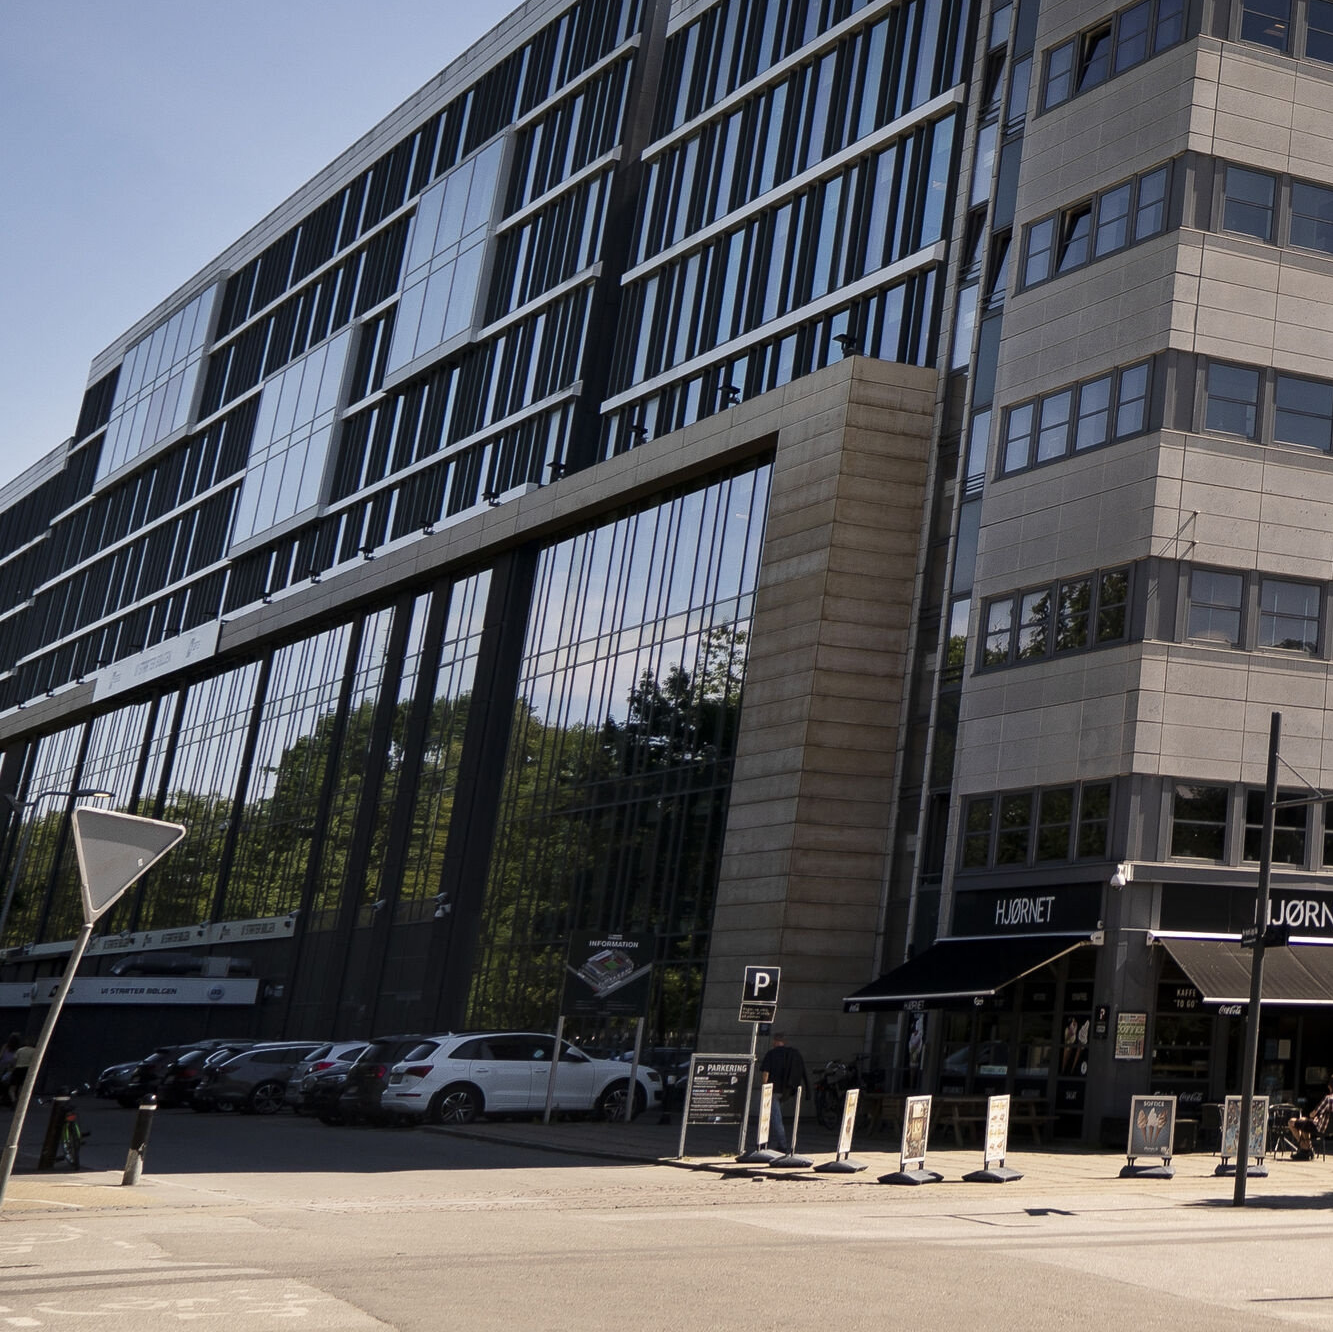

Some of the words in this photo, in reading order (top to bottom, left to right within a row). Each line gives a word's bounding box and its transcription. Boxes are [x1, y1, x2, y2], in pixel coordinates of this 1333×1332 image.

[995, 896, 1055, 925] HJØRNET
[588, 940, 639, 948] INFORMATION
[753, 972, 770, 997] P
[1176, 988, 1196, 998] KAFFE
[707, 1063, 748, 1073] PARKERING
